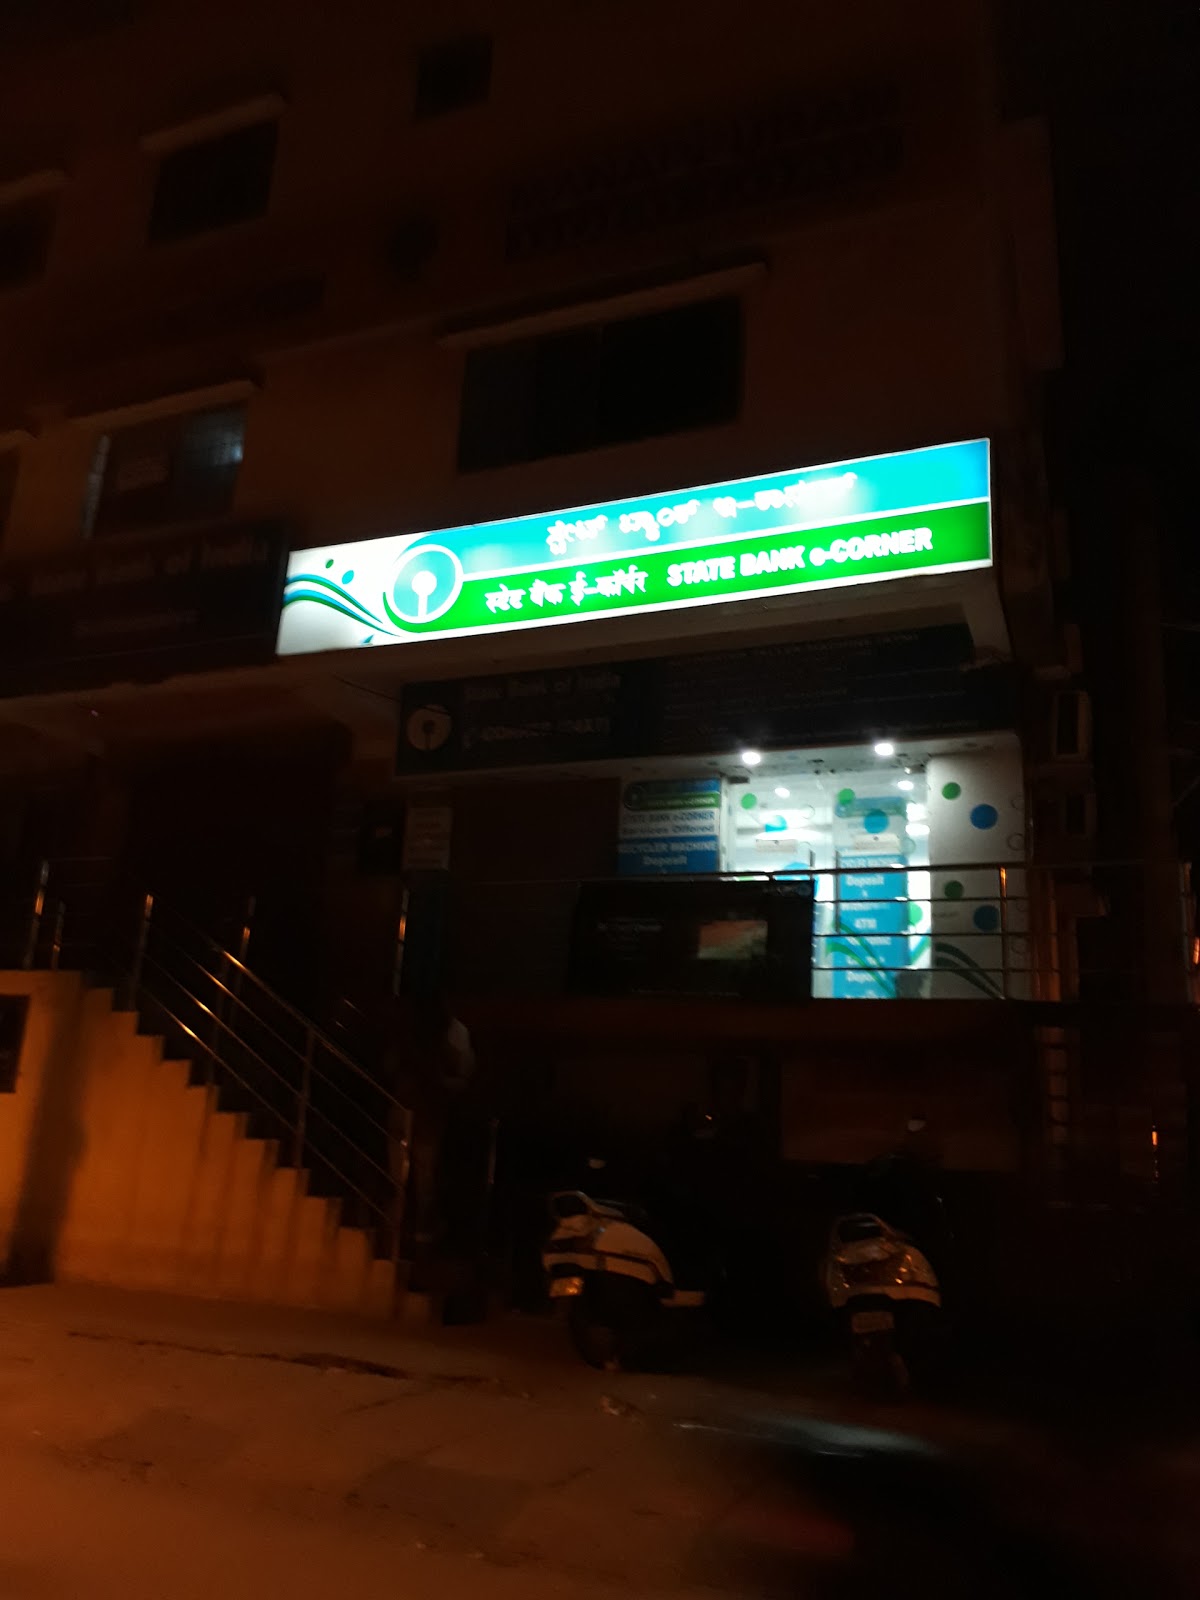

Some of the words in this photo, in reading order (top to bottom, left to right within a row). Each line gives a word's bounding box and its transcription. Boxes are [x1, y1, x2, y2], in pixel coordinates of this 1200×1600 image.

[666, 556, 735, 587] STATE
[740, 545, 806, 577] BANK
[809, 527, 933, 567] e-CORNER
